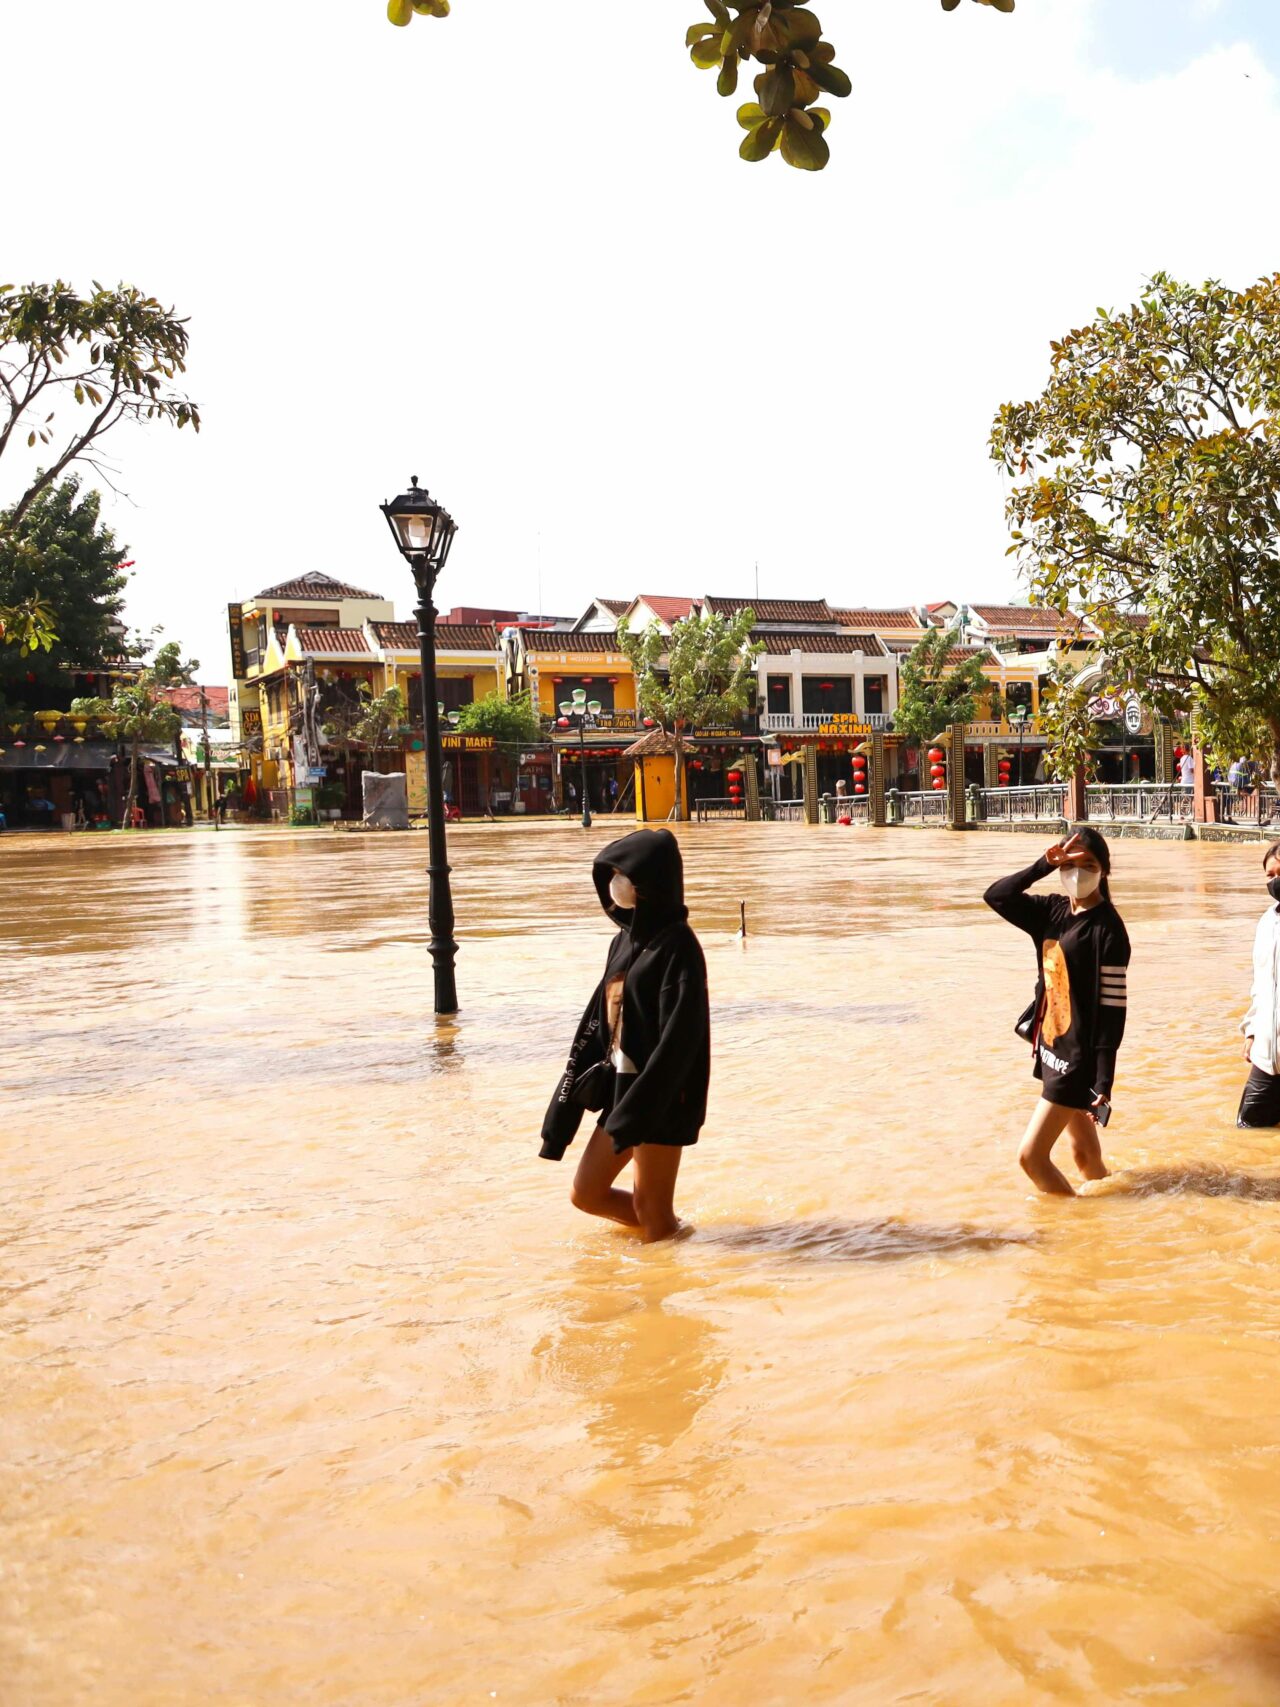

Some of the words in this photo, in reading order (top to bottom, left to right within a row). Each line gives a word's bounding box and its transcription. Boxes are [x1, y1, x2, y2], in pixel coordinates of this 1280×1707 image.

[831, 713, 859, 724] SPA
[465, 736, 494, 748] MART
[175, 768, 190, 781] SPA
[583, 1019, 600, 1036] vie
